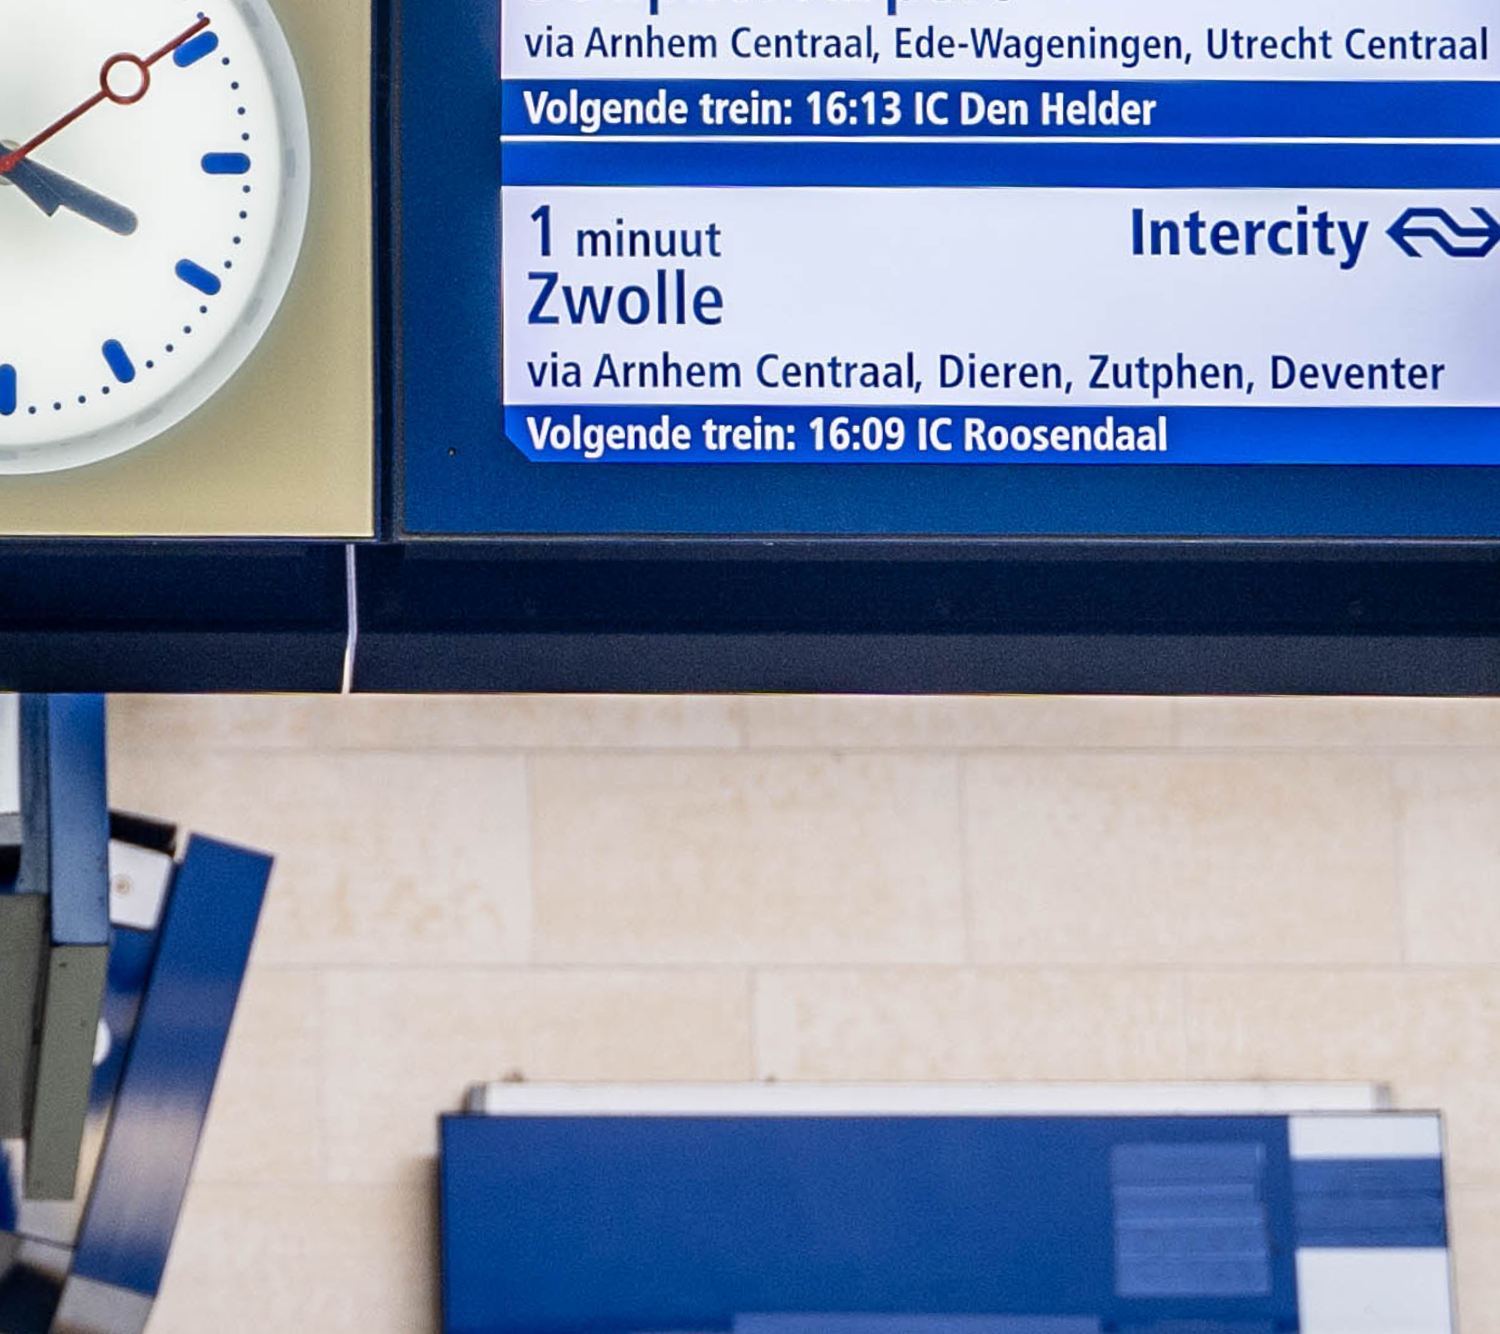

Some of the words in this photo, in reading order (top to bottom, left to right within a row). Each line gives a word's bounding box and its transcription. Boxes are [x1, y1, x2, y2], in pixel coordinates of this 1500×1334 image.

[525, 26, 574, 59] via
[585, 26, 717, 59] Arnhem
[731, 26, 879, 64] Centraal,
[894, 26, 1192, 67] Ede-Wageningen,
[1207, 27, 1333, 60] Utrecht
[1345, 27, 1489, 60] Centraal
[524, 89, 689, 133] Volgende
[699, 90, 792, 125] trein:
[807, 92, 902, 125] 16:13
[915, 92, 948, 126] IC
[960, 92, 1028, 126] Den
[1041, 90, 1157, 126] Helder
[530, 204, 553, 257] 1
[577, 219, 722, 257] minuut
[1132, 205, 1369, 270] Intercity
[527, 269, 724, 325] Zwolle
[527, 352, 581, 388] via
[593, 352, 742, 388] Arnhem
[756, 352, 922, 393] Centraal,
[939, 352, 1074, 393] Dieren,
[1088, 352, 1255, 398] Zutphen,
[1271, 354, 1445, 390] Deventer
[527, 415, 692, 458] Volgende
[703, 416, 796, 451] trein:
[810, 418, 905, 451] 16:09
[918, 418, 953, 452] IC
[965, 416, 1168, 452] Roosendaal
